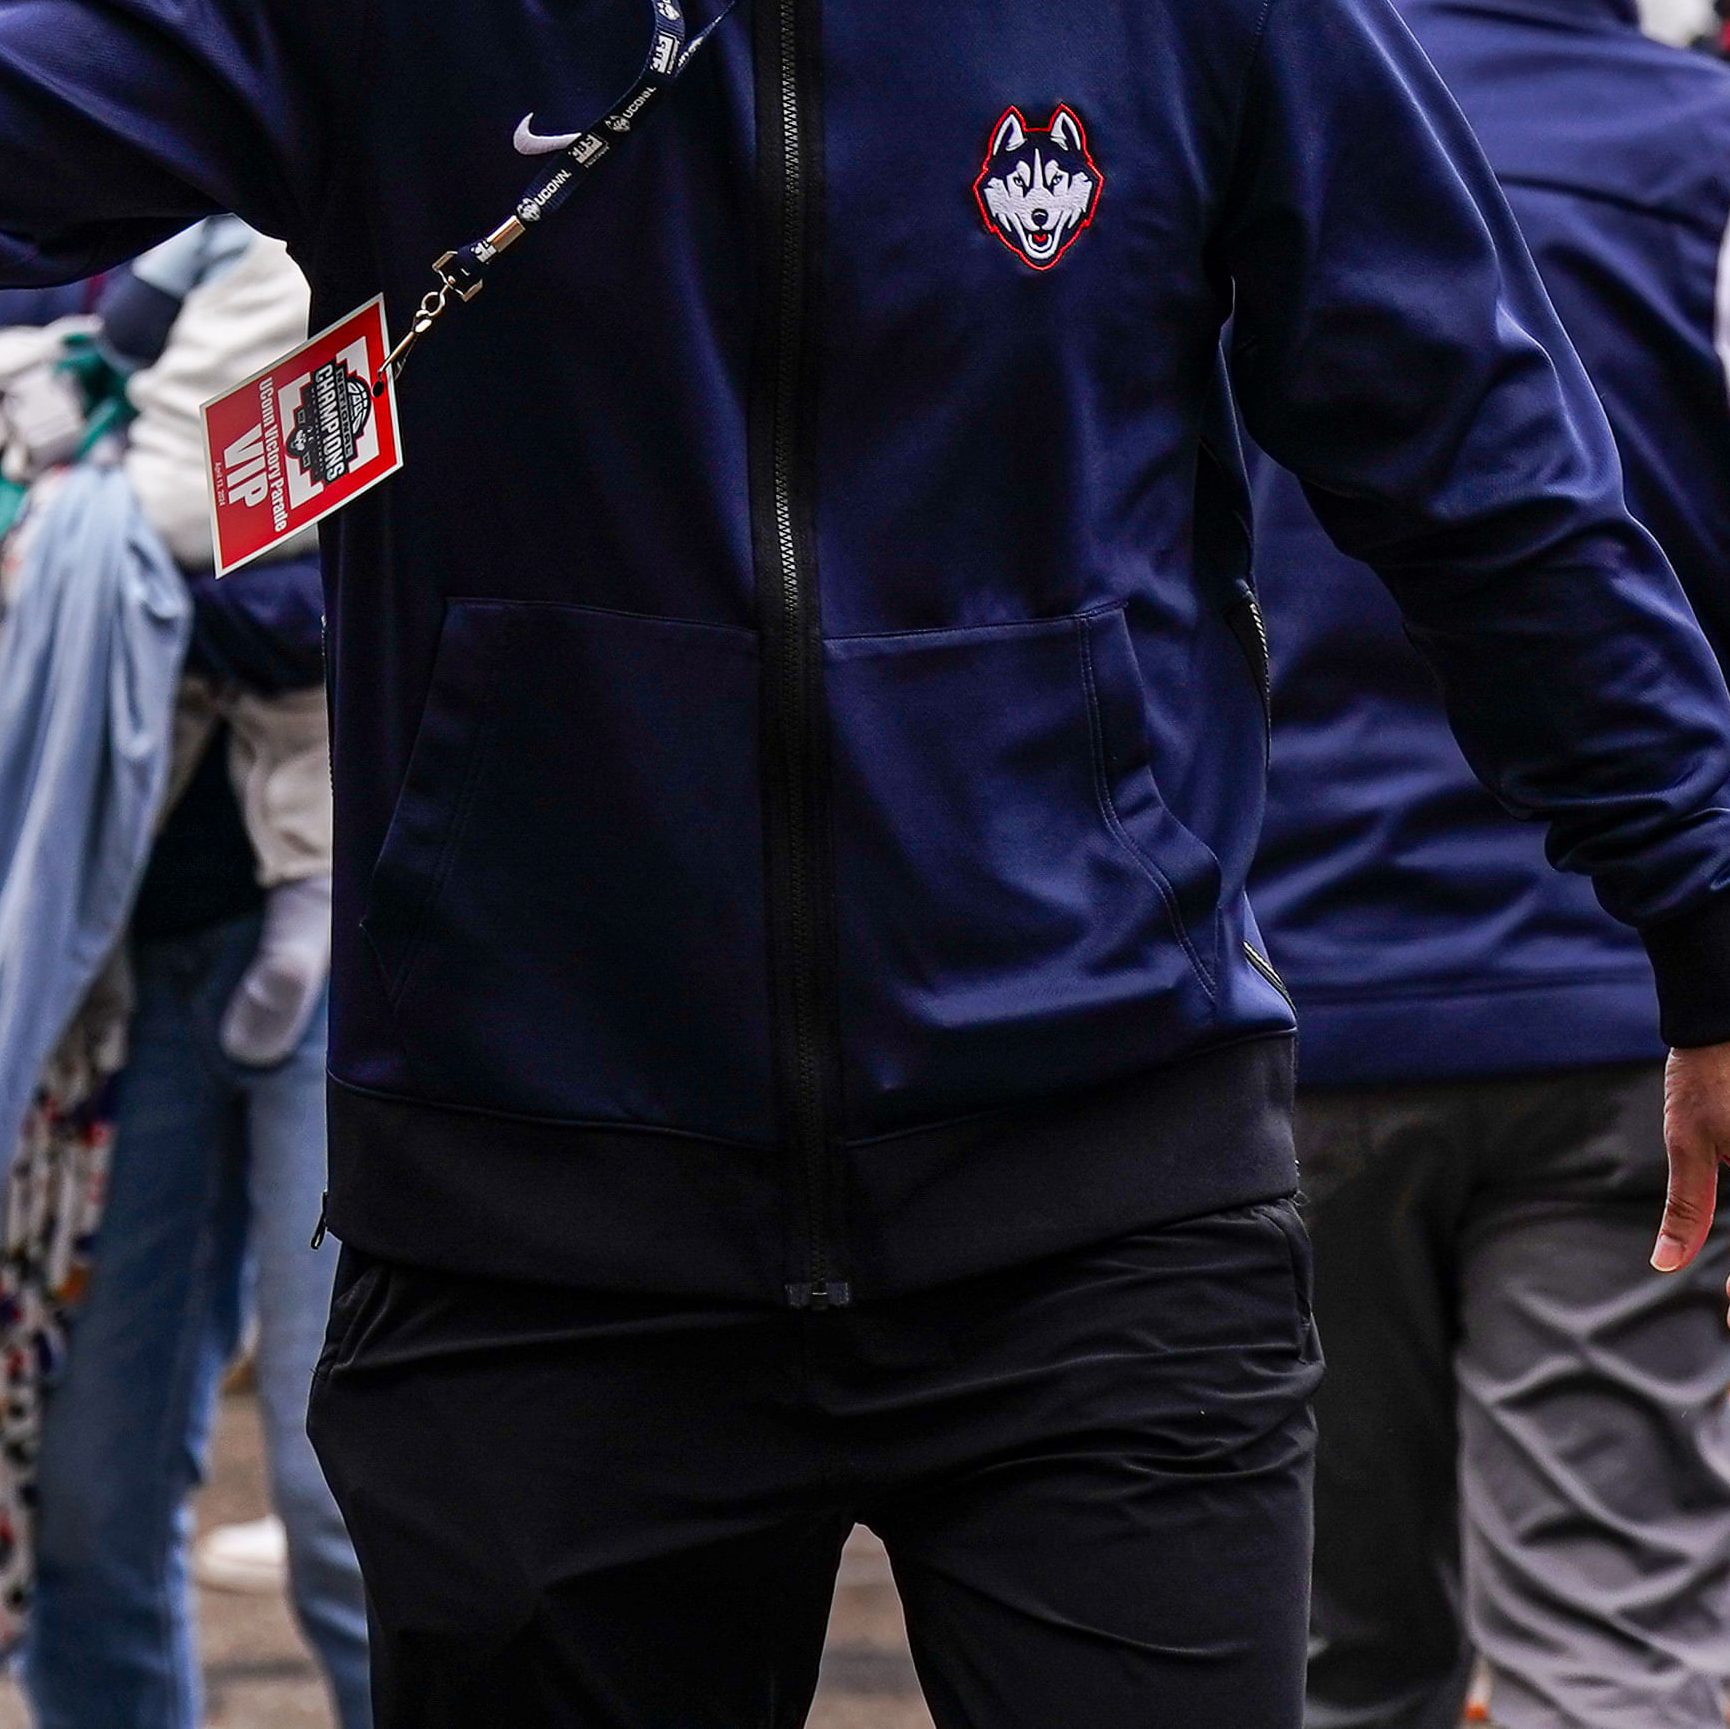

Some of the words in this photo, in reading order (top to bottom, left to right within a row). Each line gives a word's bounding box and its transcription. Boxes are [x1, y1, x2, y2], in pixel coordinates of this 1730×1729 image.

[623, 85, 657, 120] UCONN
[534, 169, 572, 207] UCONN
[258, 376, 276, 428] UConn
[314, 363, 346, 482] CHAMPIONS
[335, 368, 353, 459] NATIONAL
[223, 422, 269, 508] VIP
[264, 423, 285, 481] Victory
[270, 477, 289, 533] Parade
